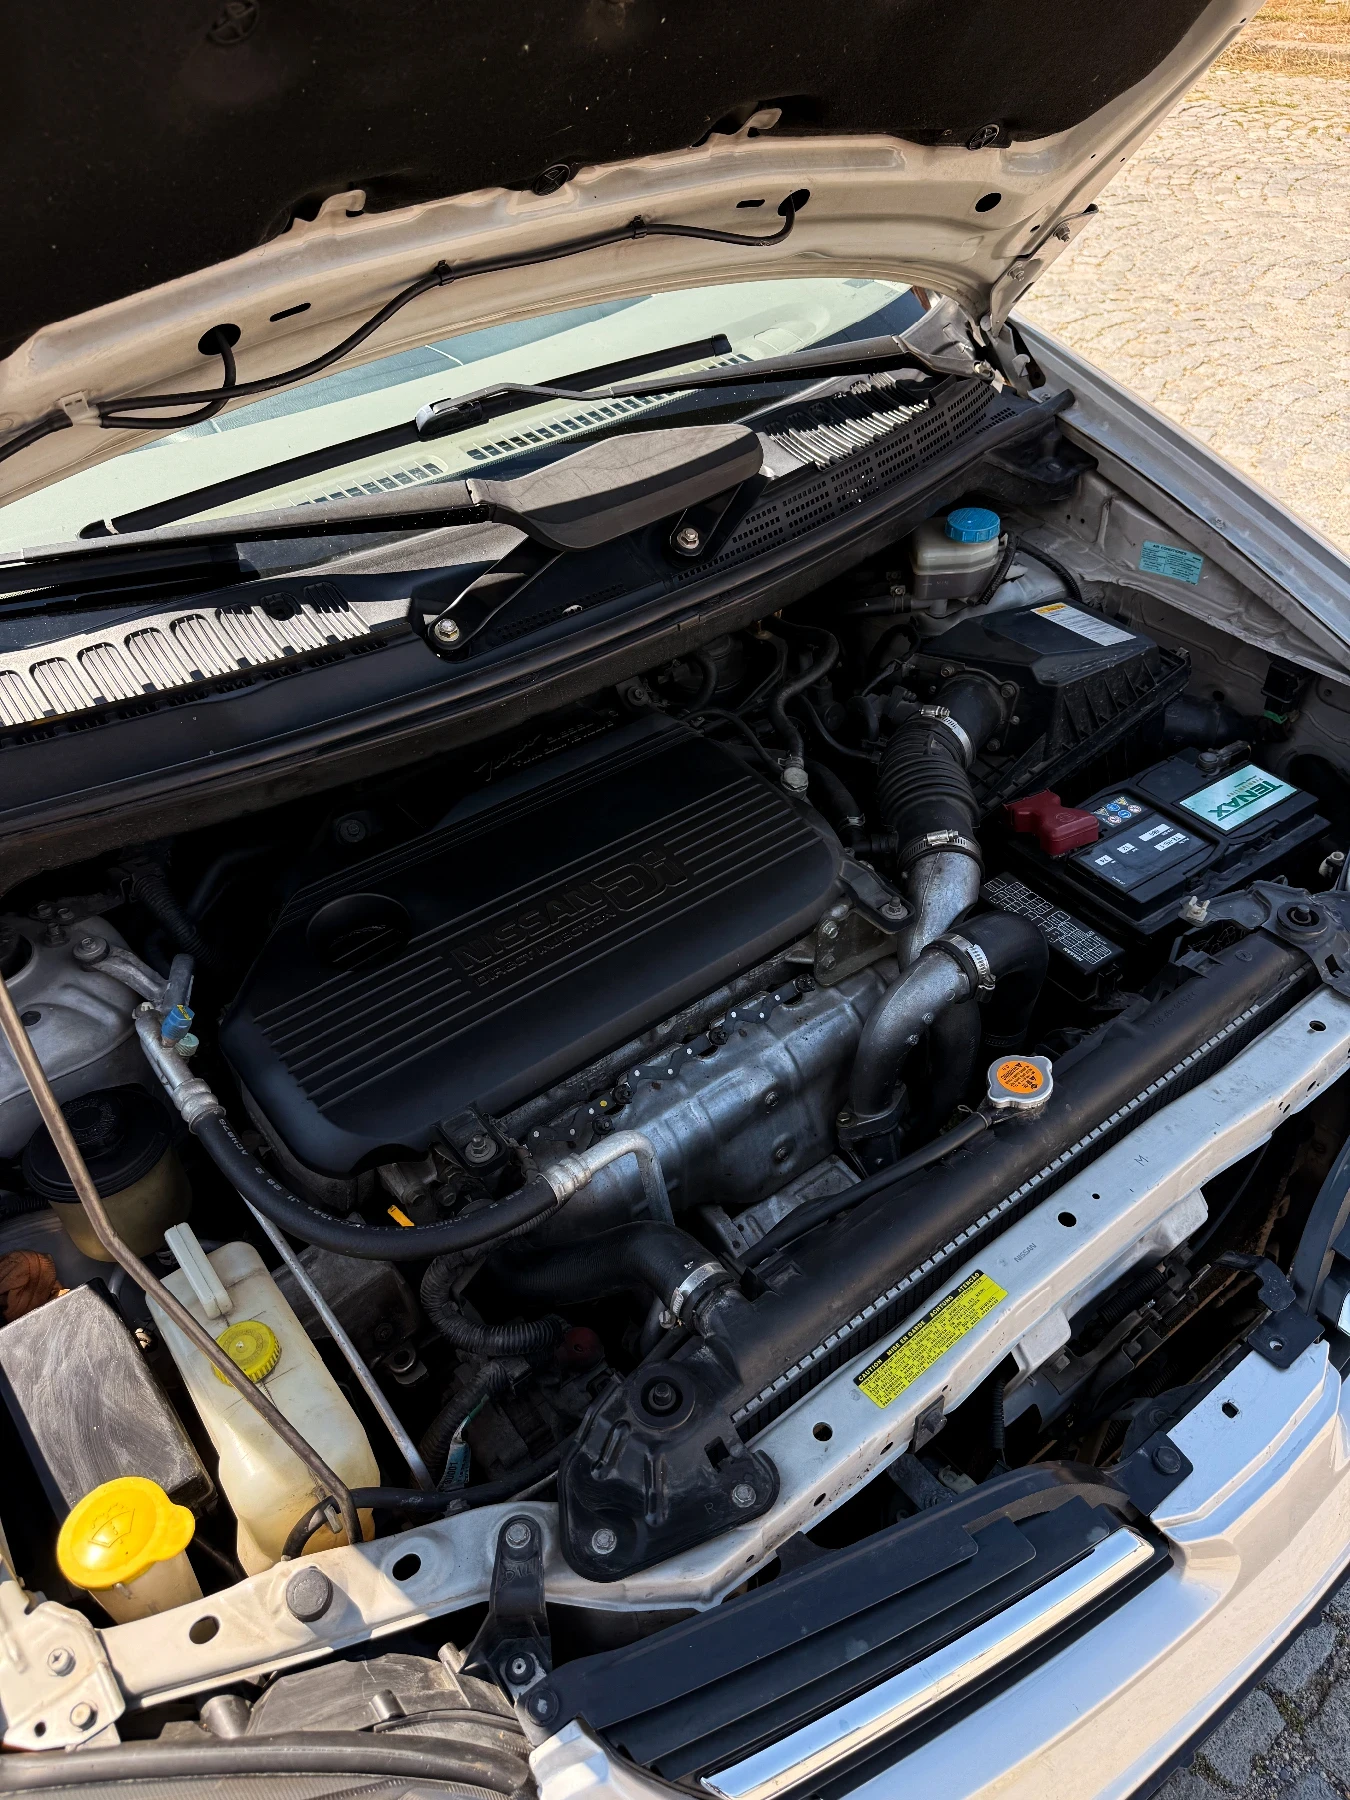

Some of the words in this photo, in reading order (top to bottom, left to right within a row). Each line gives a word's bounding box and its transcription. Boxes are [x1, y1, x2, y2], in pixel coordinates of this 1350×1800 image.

[1208, 781, 1284, 821] TENAX
[1014, 1242, 1037, 1263] NISSAN
[858, 1358, 883, 1382] CAUTION
[885, 1340, 902, 1357] MISE
[899, 1332, 910, 1345] EN
[907, 1319, 926, 1338] GARDE
[929, 1294, 954, 1318] ACHTUNG
